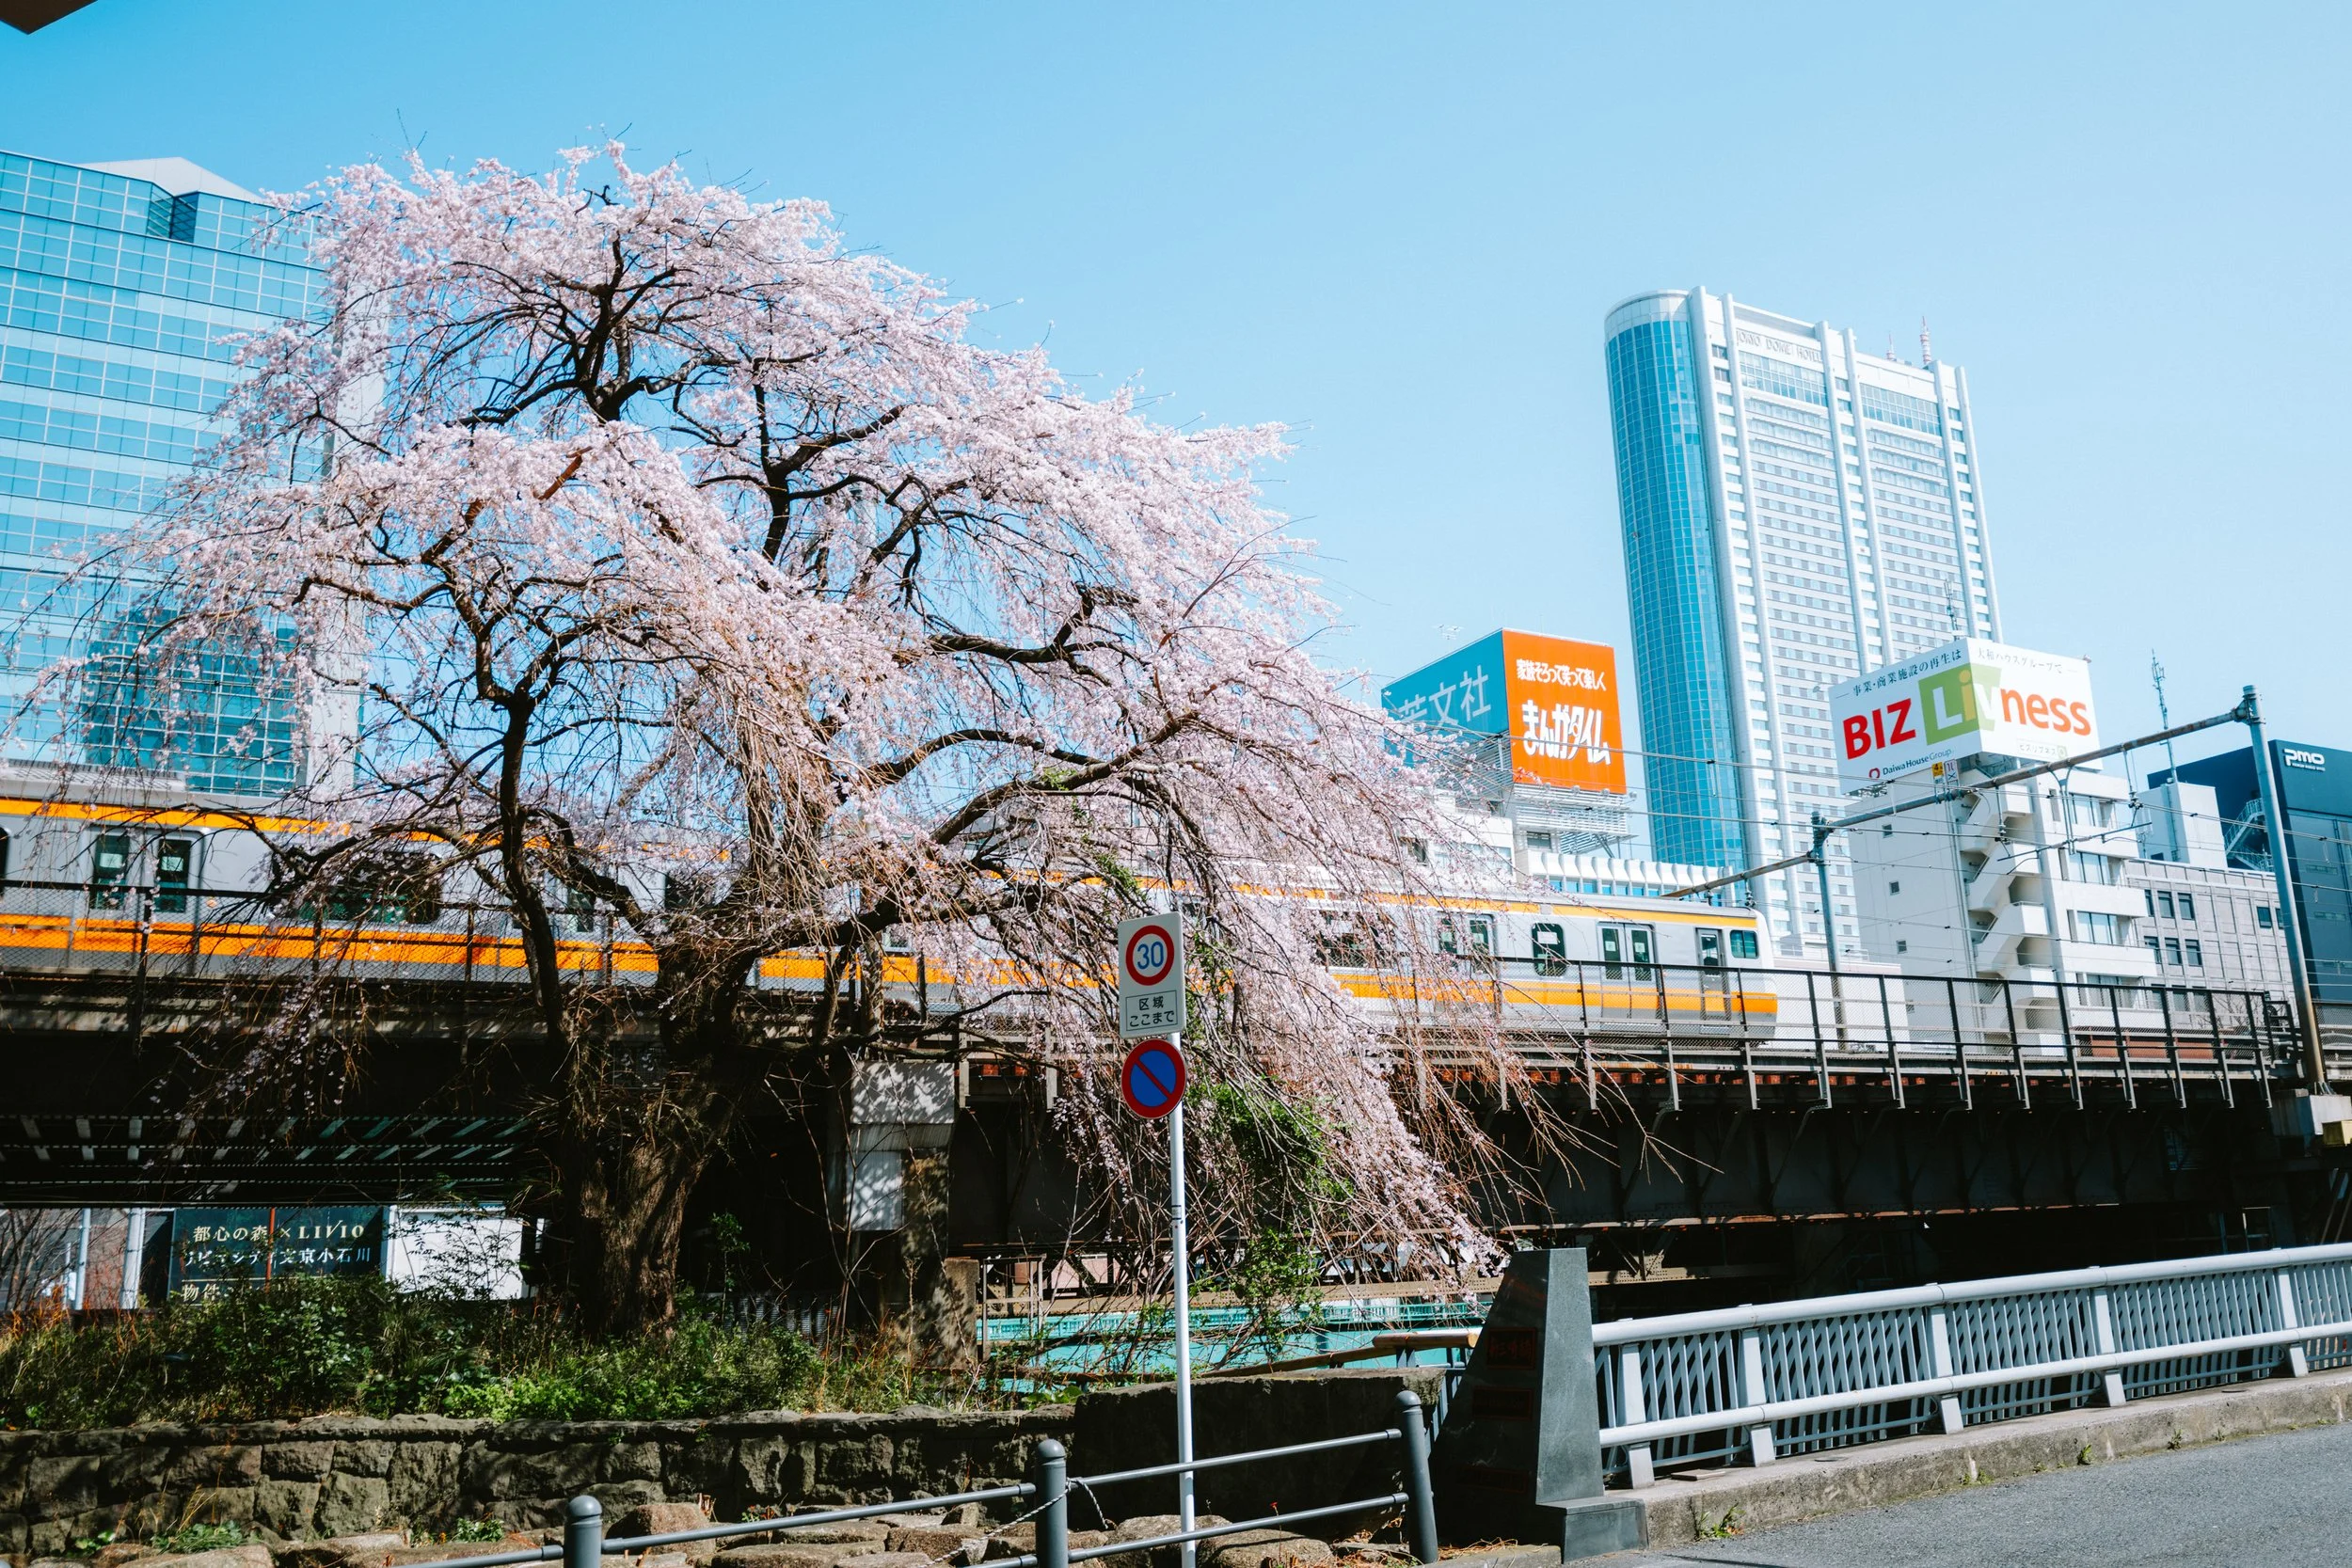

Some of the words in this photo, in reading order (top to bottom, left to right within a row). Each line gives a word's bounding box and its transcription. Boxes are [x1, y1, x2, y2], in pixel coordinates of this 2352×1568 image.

[1521, 699, 1611, 765] まんがタイム
[1843, 698, 1916, 760] BIZ
[1883, 763, 1906, 775] Daiwa
[1906, 754, 1930, 768] House
[1929, 749, 1952, 761] Group
[1136, 941, 1165, 970] 30
[1138, 995, 1165, 1011] 区域
[1129, 1009, 1175, 1028] ここまで
[298, 1220, 365, 1240] LIVIO
